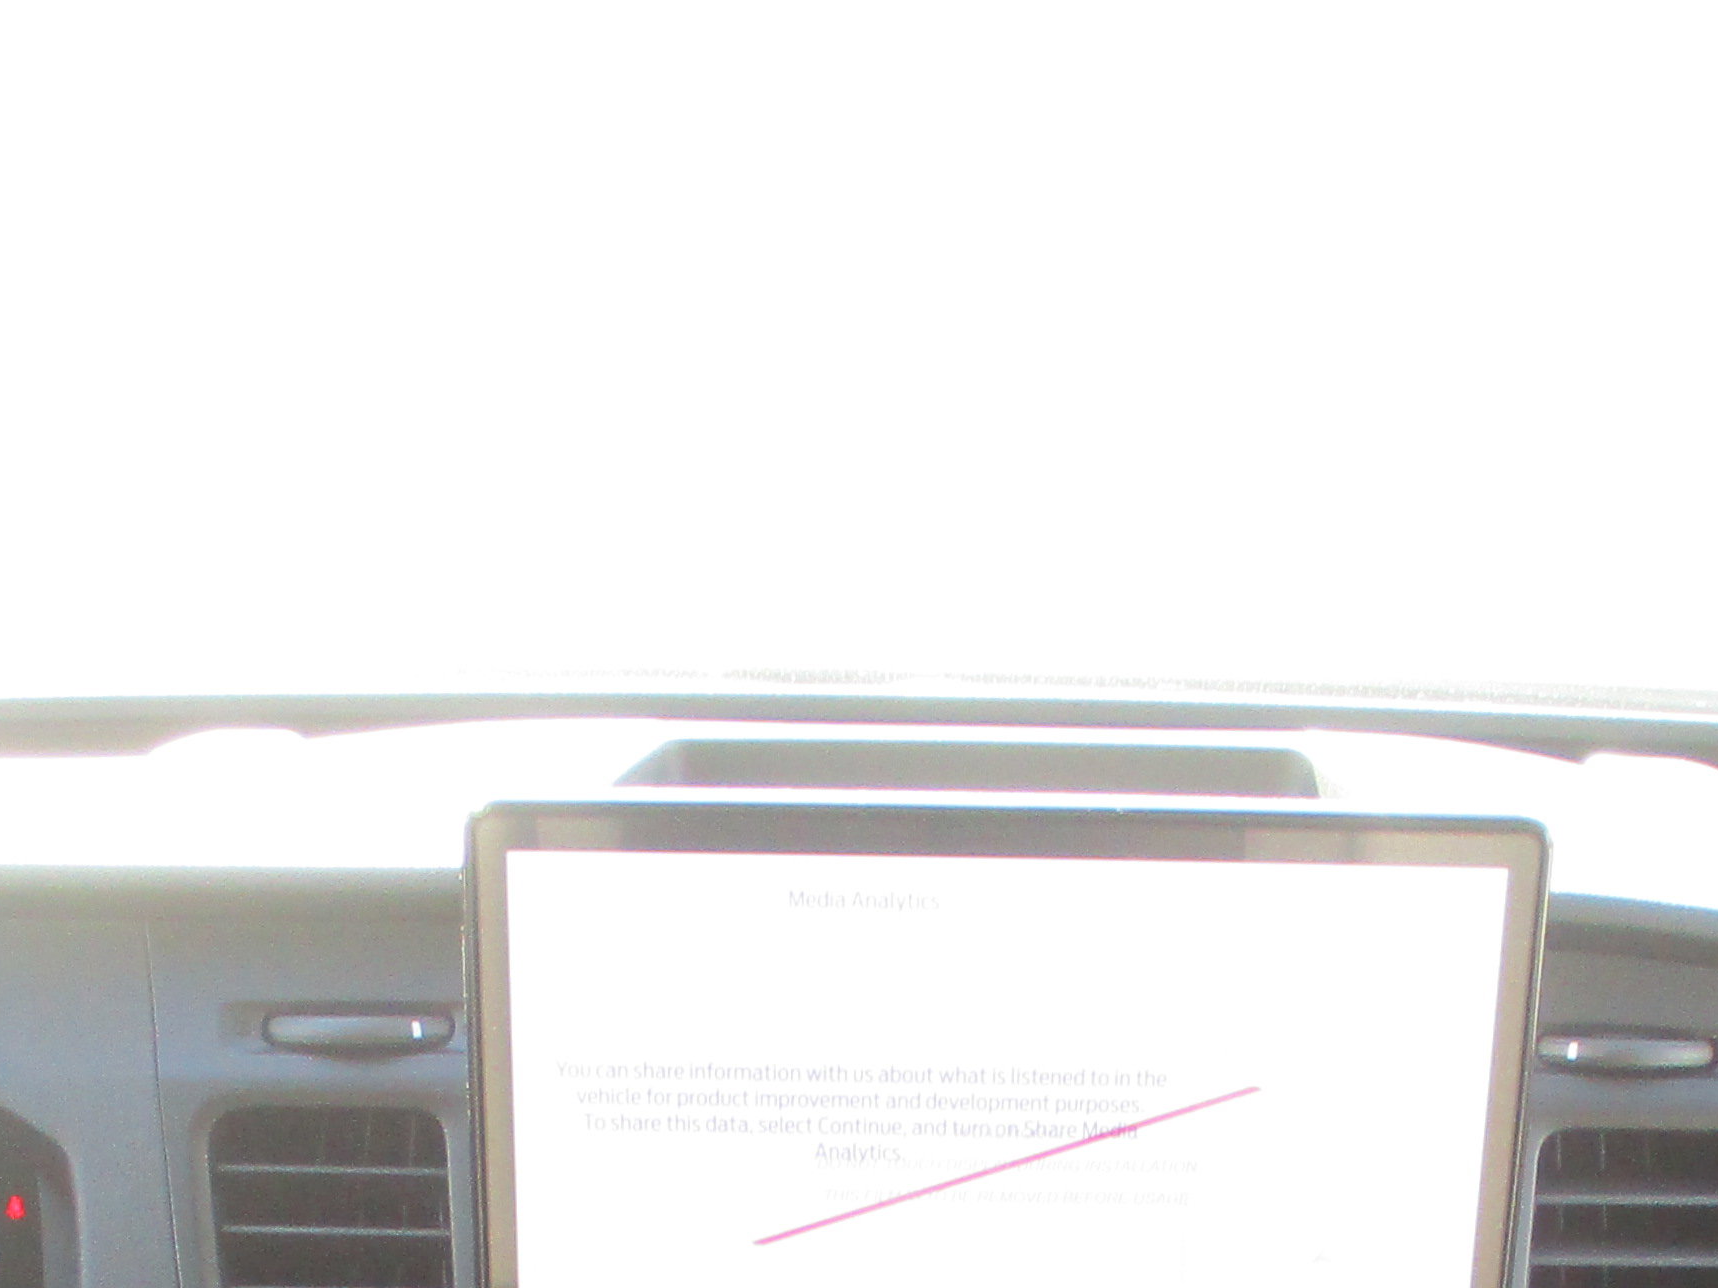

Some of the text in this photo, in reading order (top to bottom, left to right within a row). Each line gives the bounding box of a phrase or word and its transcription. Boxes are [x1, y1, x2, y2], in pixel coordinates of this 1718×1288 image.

[788, 889, 940, 912] Media Analytics
[556, 1060, 1167, 1088] You can share information with us about what is listened to in the
[577, 1087, 1145, 1115] vehicle for product improvement and development purposes.
[585, 1112, 1138, 1140] To share this data, select Continue, and turn on Share Media
[815, 1141, 906, 1163] Analytics.
[1084, 1158, 1198, 1173] INSTALLATION
[977, 1190, 1058, 1204] REMOVED
[1063, 1190, 1128, 1205] BEFORE
